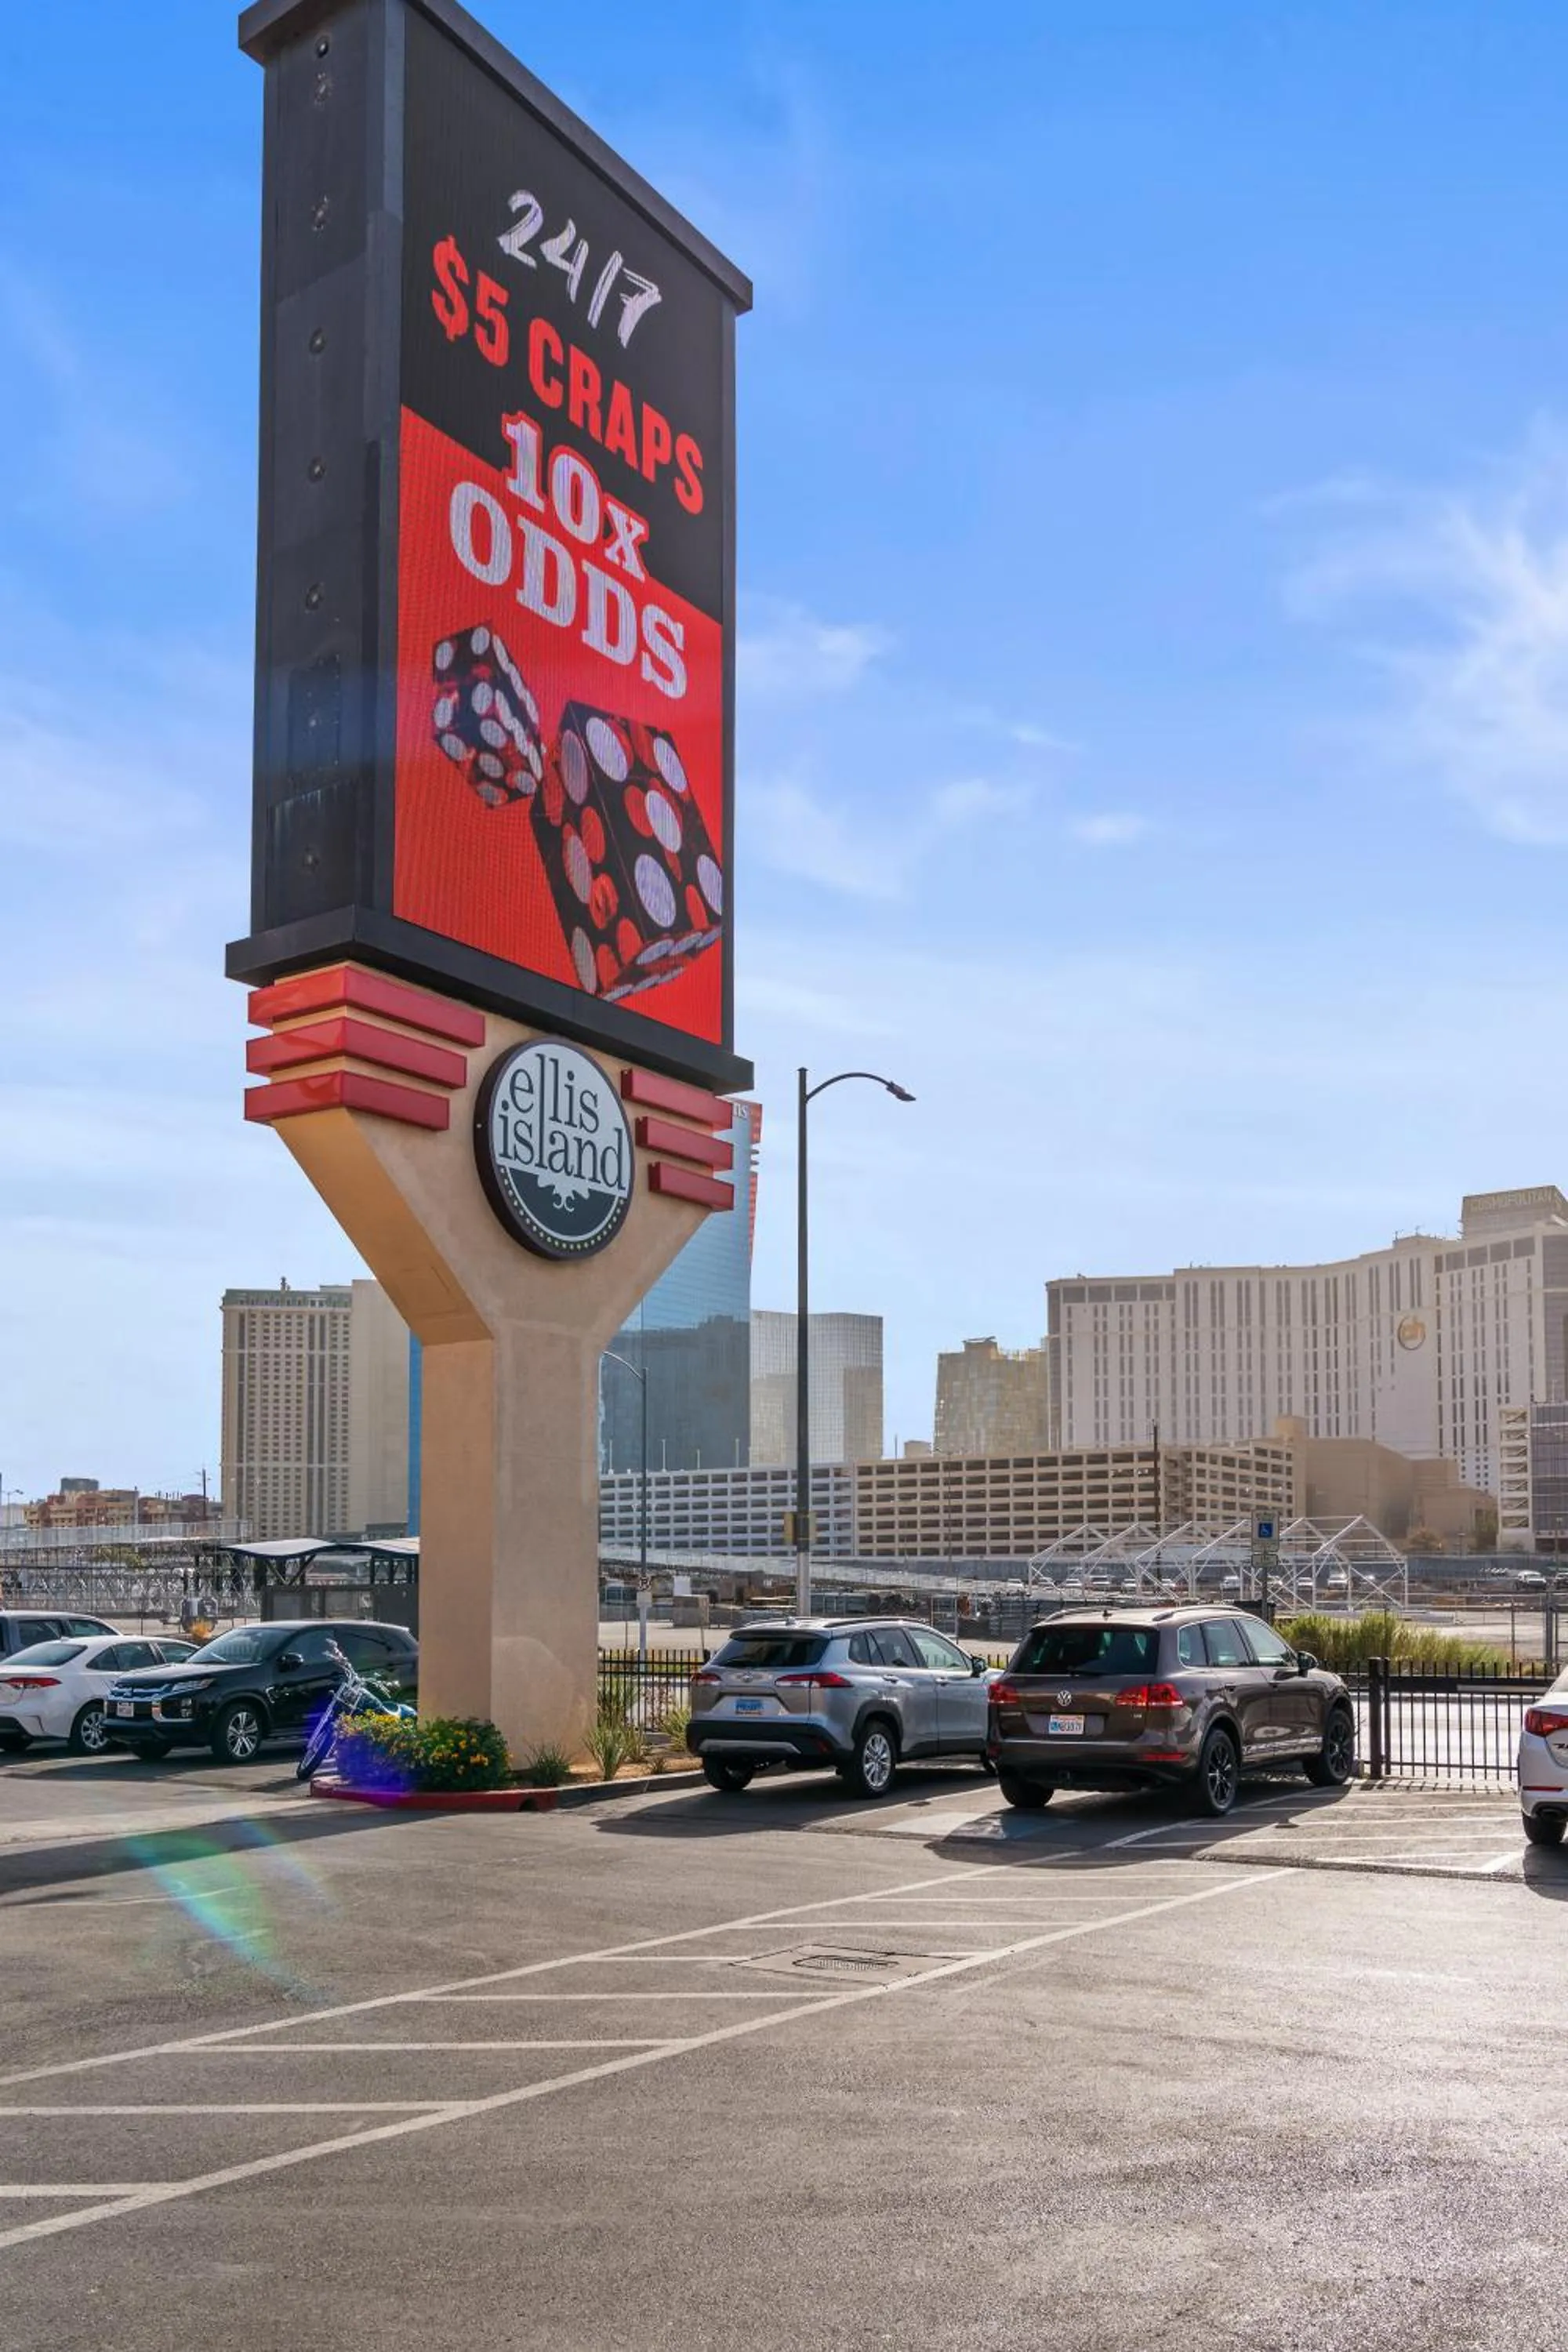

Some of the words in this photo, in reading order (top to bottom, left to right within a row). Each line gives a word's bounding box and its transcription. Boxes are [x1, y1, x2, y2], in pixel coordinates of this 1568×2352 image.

[432, 235, 509, 366] $5
[528, 318, 703, 514] CRAPS
[449, 481, 688, 699] ODDS
[498, 1099, 626, 1191] island
[510, 1053, 600, 1134] ellis
